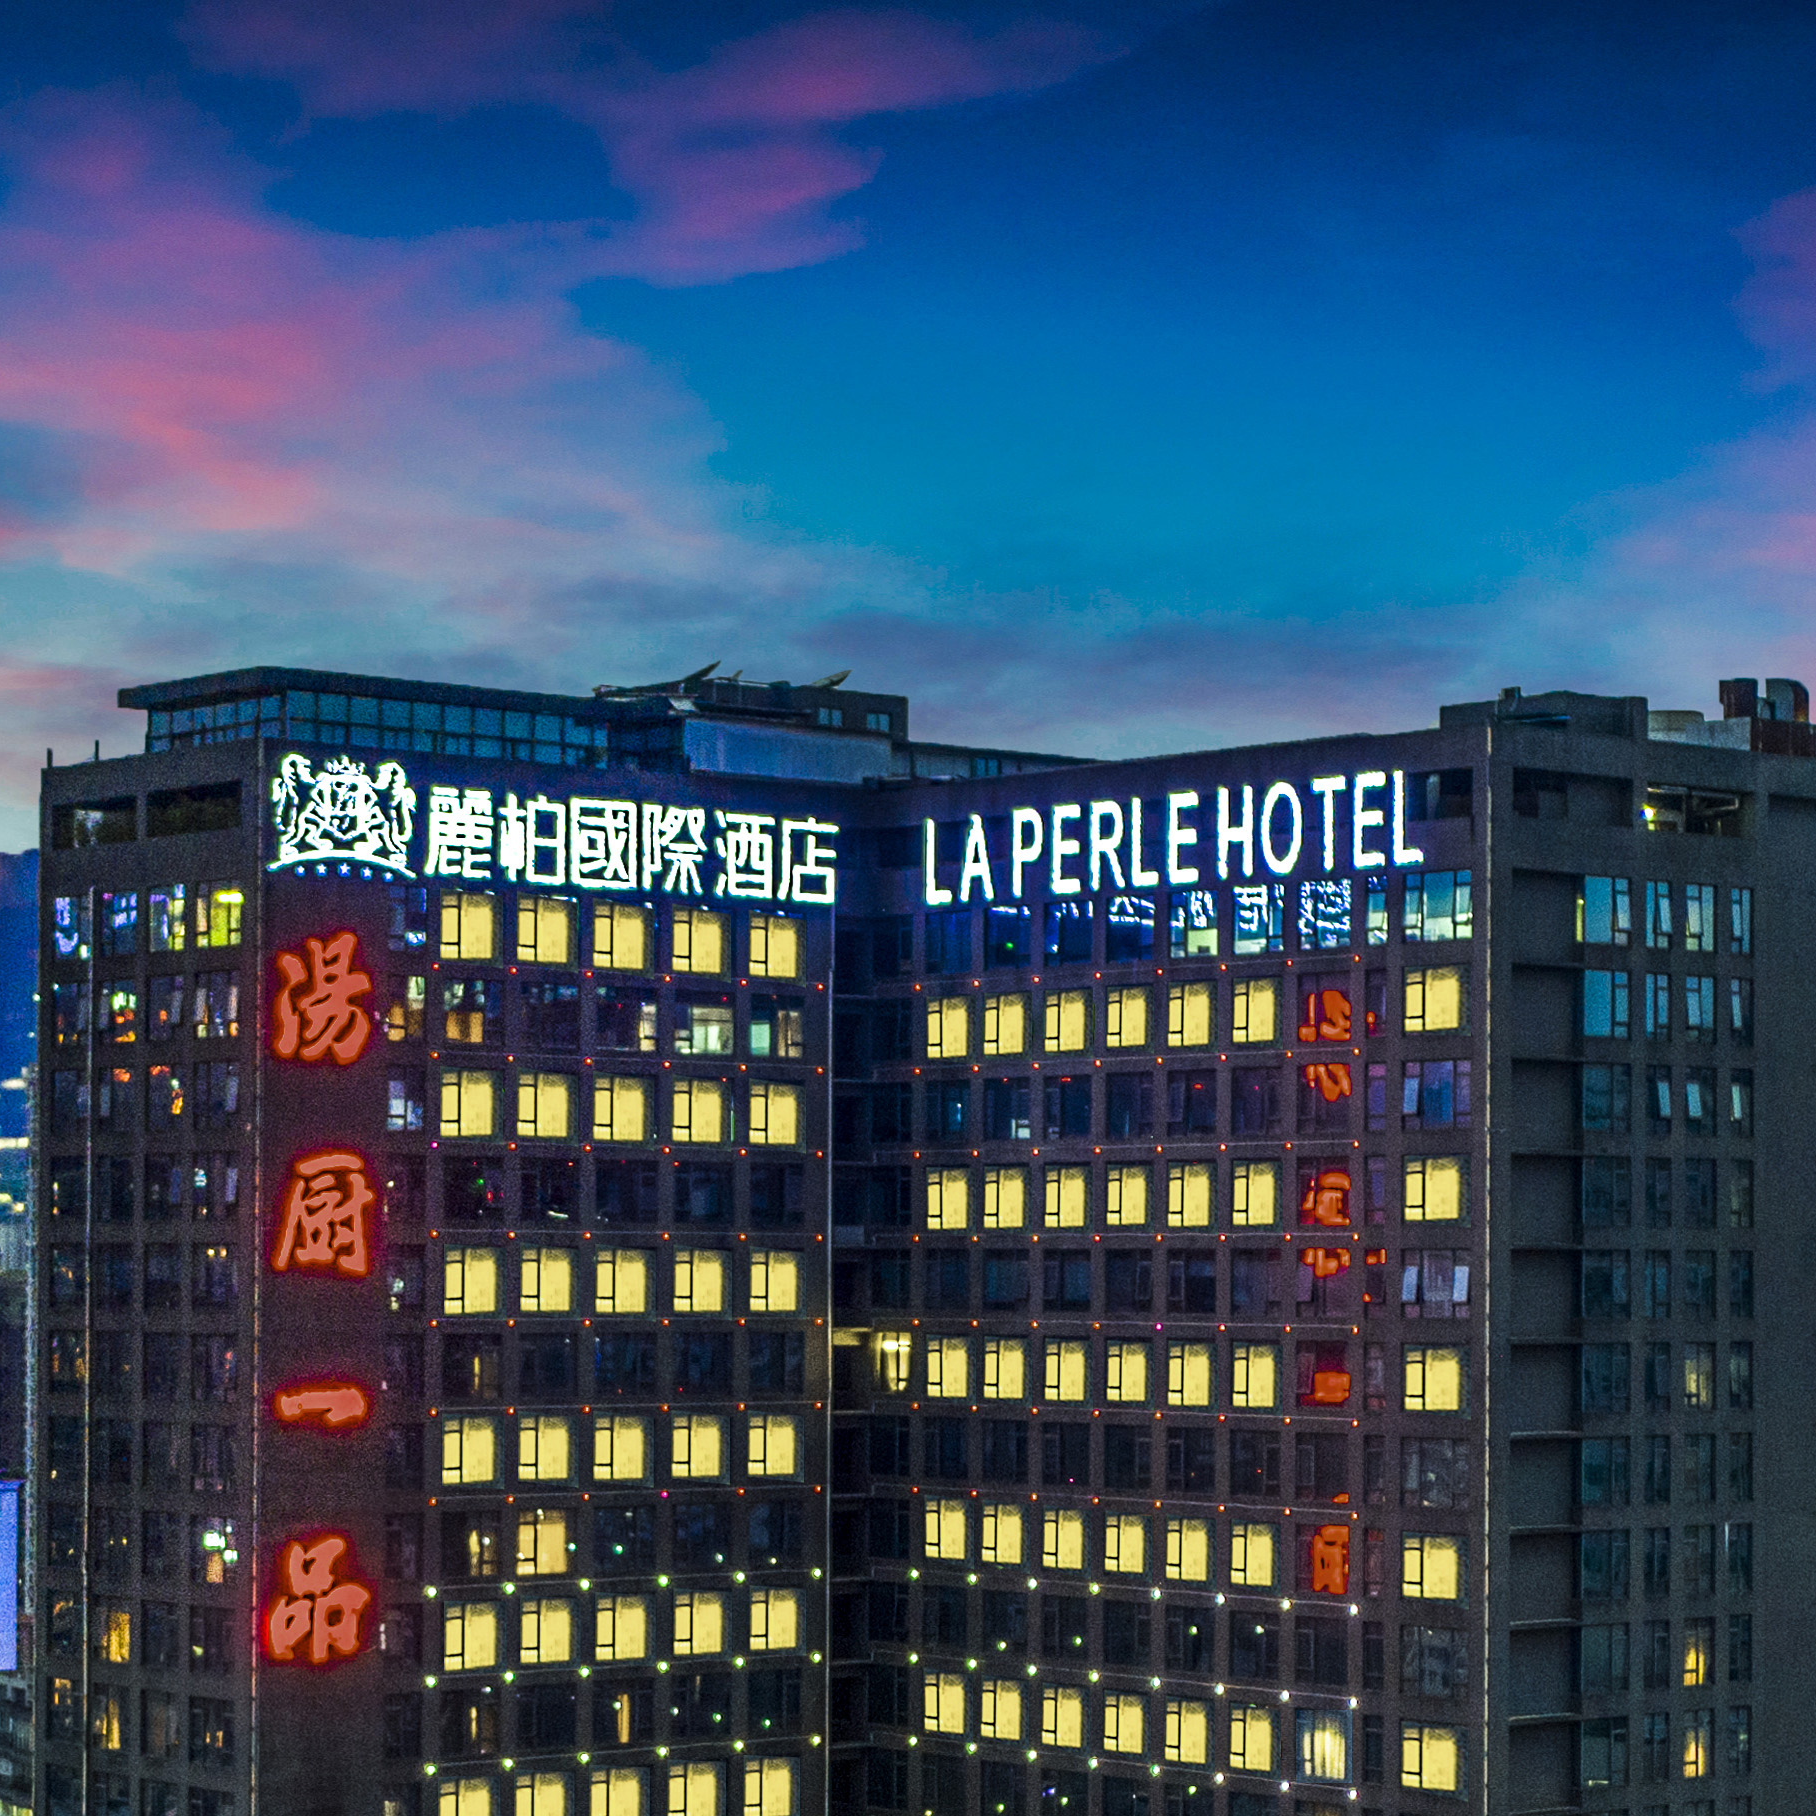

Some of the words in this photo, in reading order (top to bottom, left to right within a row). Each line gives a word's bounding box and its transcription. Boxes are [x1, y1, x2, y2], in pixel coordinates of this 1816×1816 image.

[424, 786, 840, 905] 麗柏國際酒店
[926, 814, 994, 905] LA
[1012, 790, 1200, 894] PERLE
[1217, 769, 1425, 880] HOTEL
